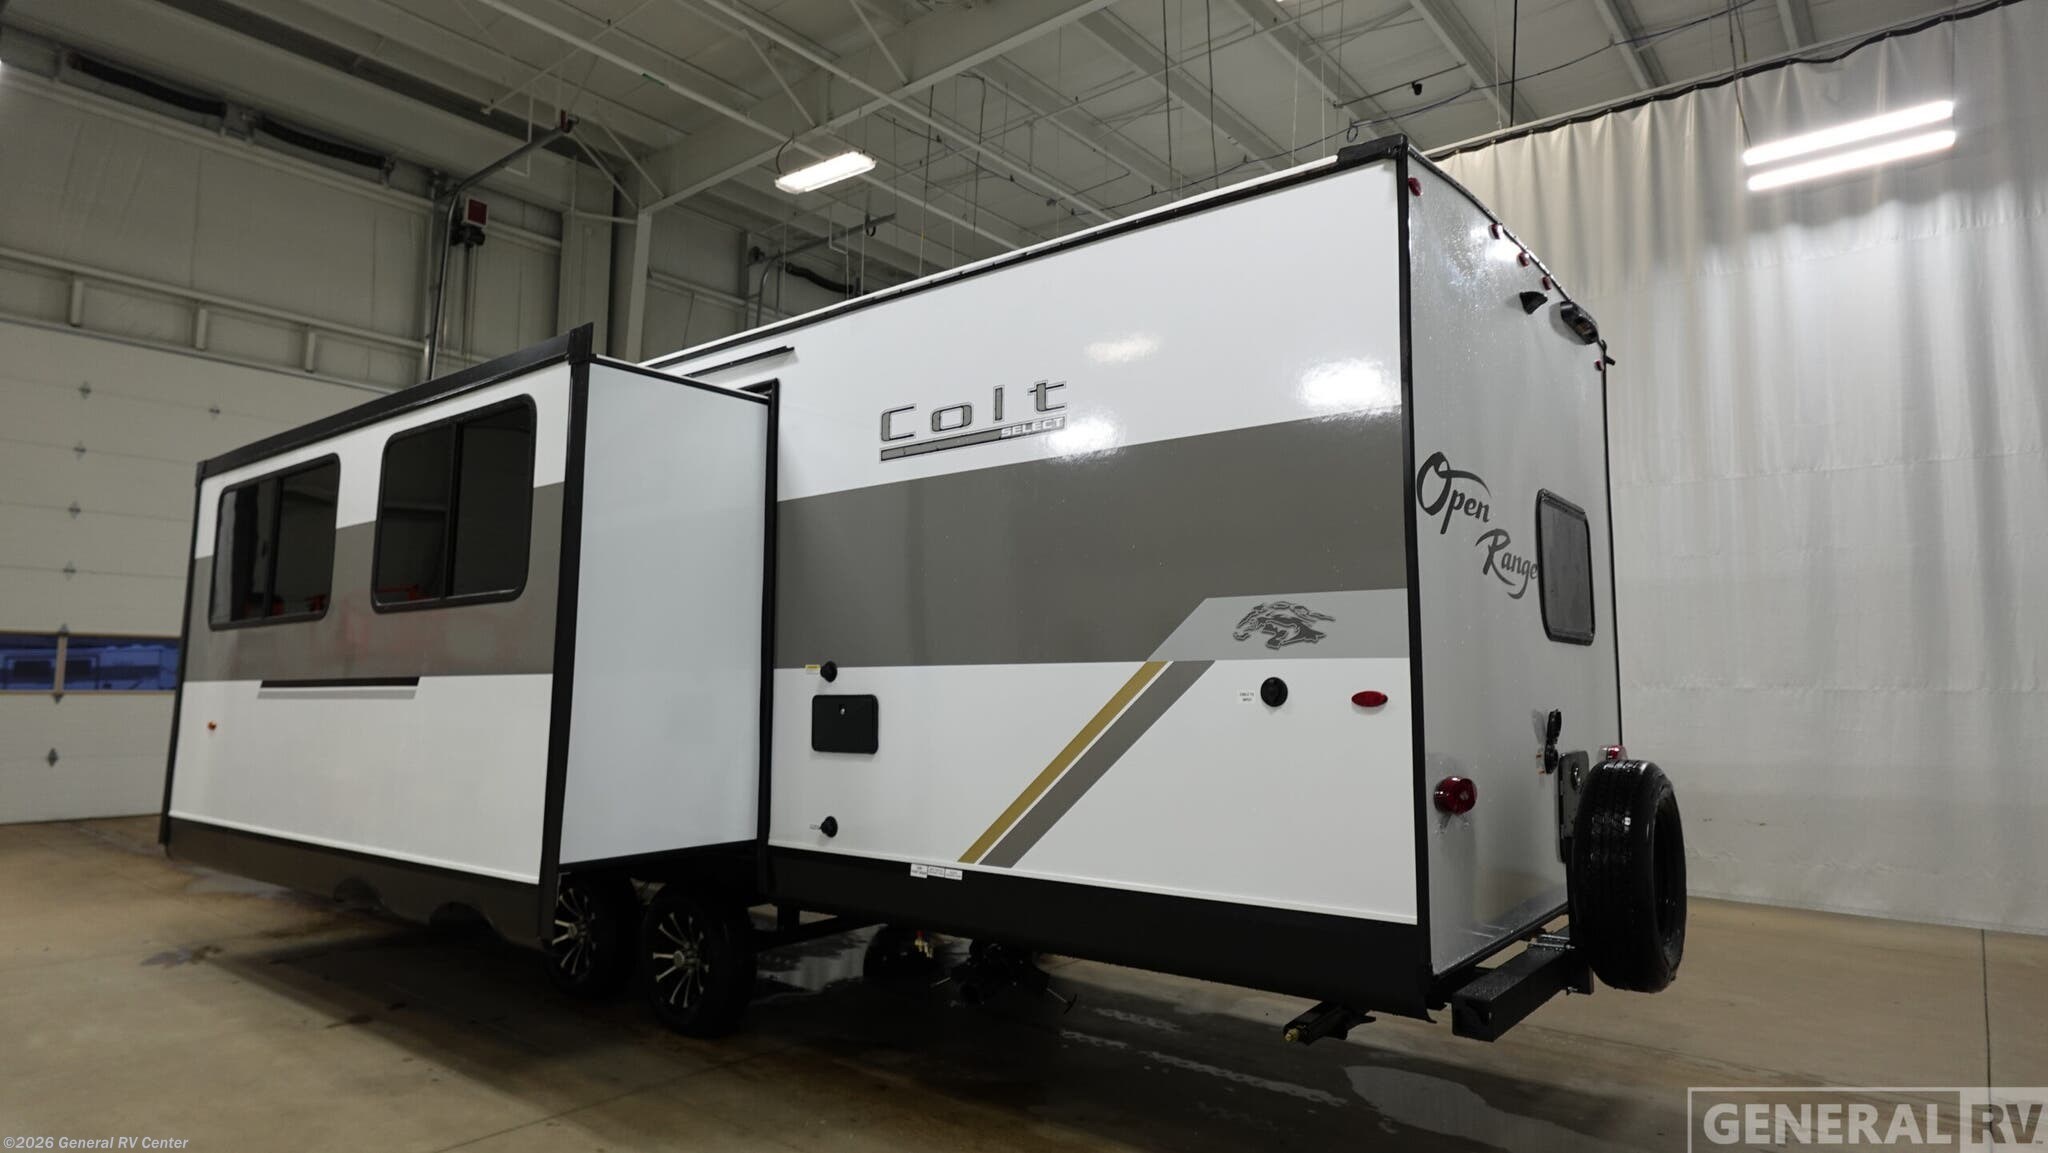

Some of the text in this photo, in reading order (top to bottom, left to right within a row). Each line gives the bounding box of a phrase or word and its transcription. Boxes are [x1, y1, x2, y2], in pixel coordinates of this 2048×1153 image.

[880, 380, 1067, 442] Colt
[1001, 418, 1065, 439] SELECT
[1416, 451, 1491, 535] Open
[1475, 528, 1538, 599] Range
